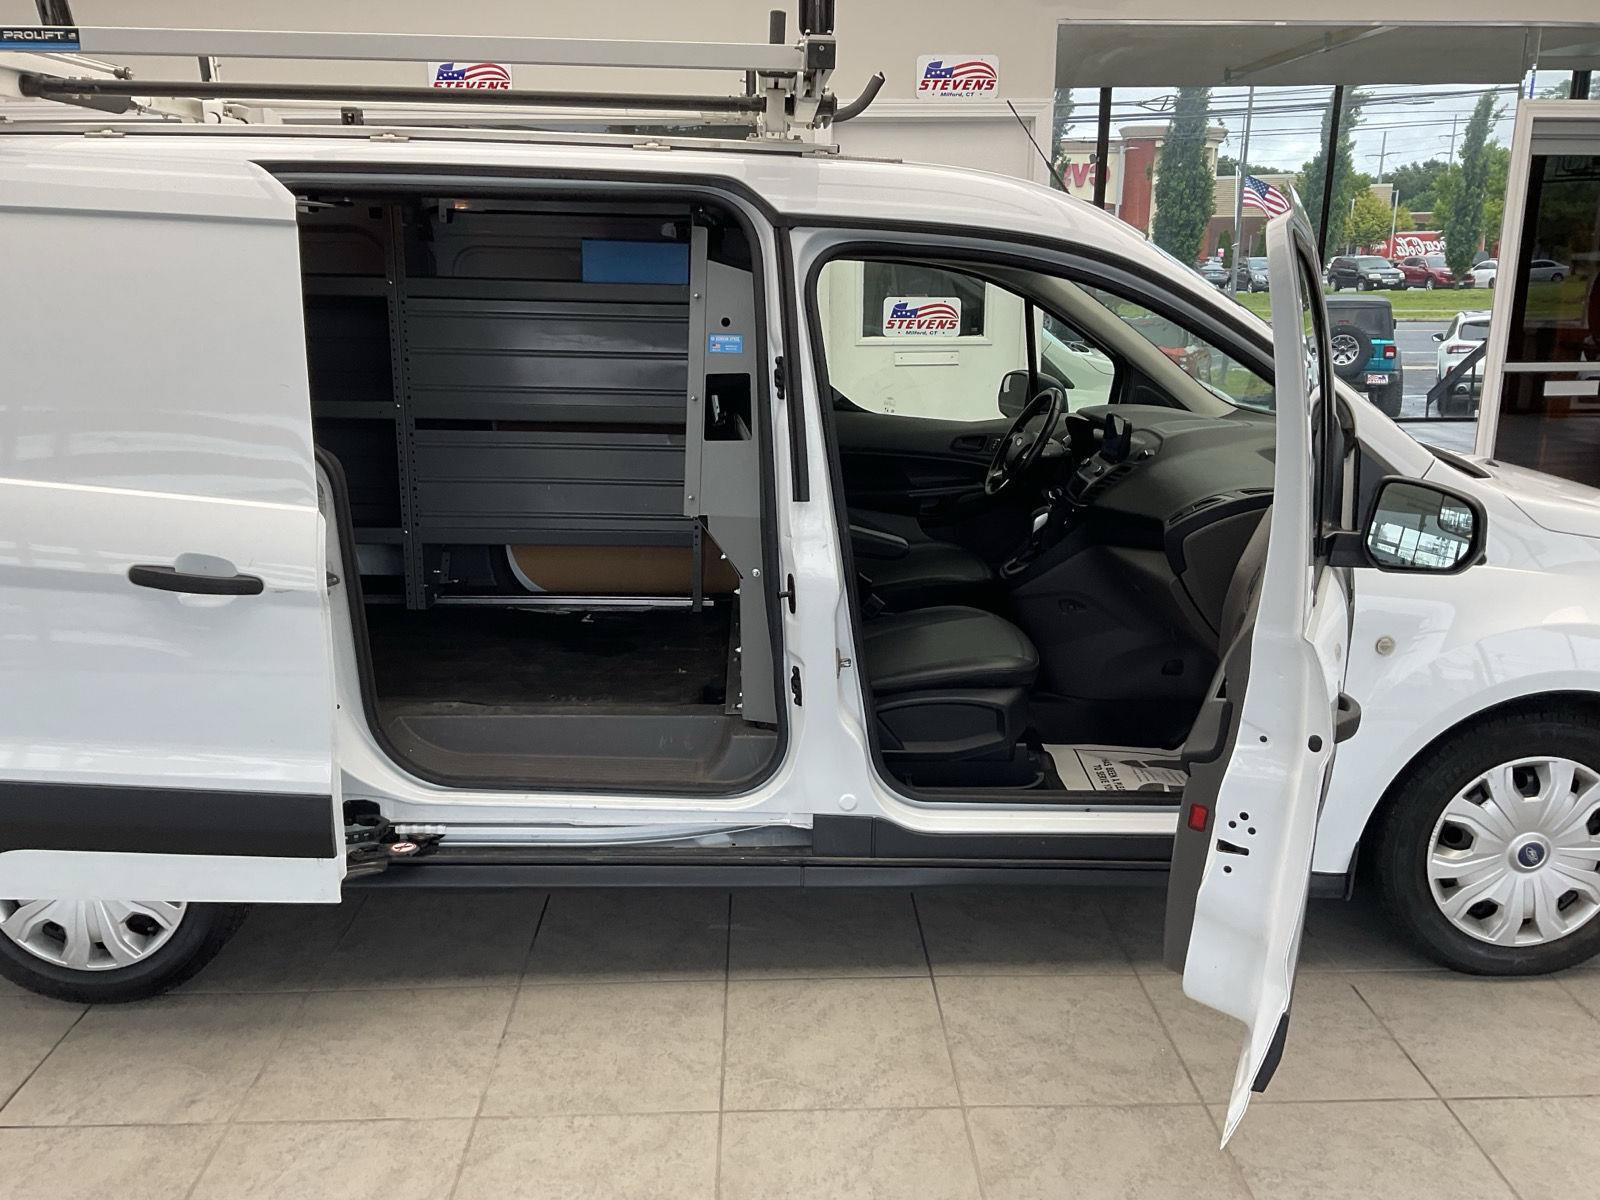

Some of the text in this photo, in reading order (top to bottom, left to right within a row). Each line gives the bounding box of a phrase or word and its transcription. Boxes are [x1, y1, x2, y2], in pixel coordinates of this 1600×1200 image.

[2, 30, 65, 40] PROLIFT
[433, 81, 511, 90] STEVENS
[918, 79, 997, 91] STEVENS
[885, 319, 959, 330] STEVENS
